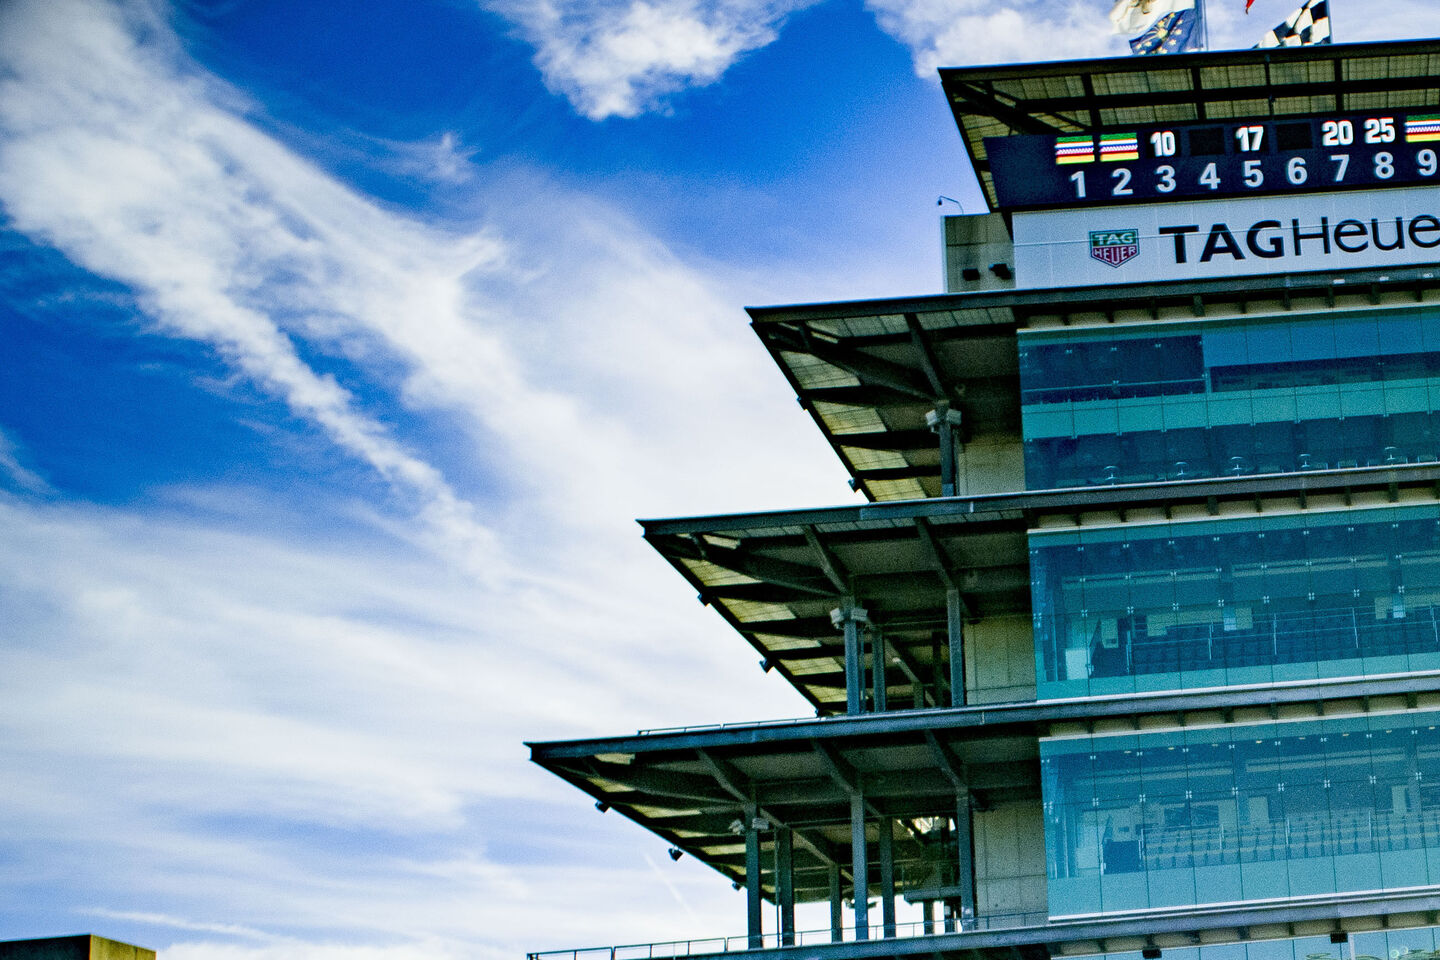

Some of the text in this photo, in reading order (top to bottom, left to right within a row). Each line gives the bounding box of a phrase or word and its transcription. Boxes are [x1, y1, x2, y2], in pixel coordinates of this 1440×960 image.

[1150, 117, 1396, 157] 10 17 20 25
[1069, 171, 1087, 198] 1
[1111, 168, 1134, 196] 2
[1155, 165, 1177, 193] 3
[1199, 162, 1221, 190] 4
[1243, 160, 1265, 188] 5
[1286, 157, 1308, 185] 6
[1329, 154, 1350, 182] 7
[1374, 152, 1395, 180] 8
[1417, 149, 1438, 177] 9
[1094, 233, 1134, 246] TAG
[1093, 246, 1137, 265] HEUER
